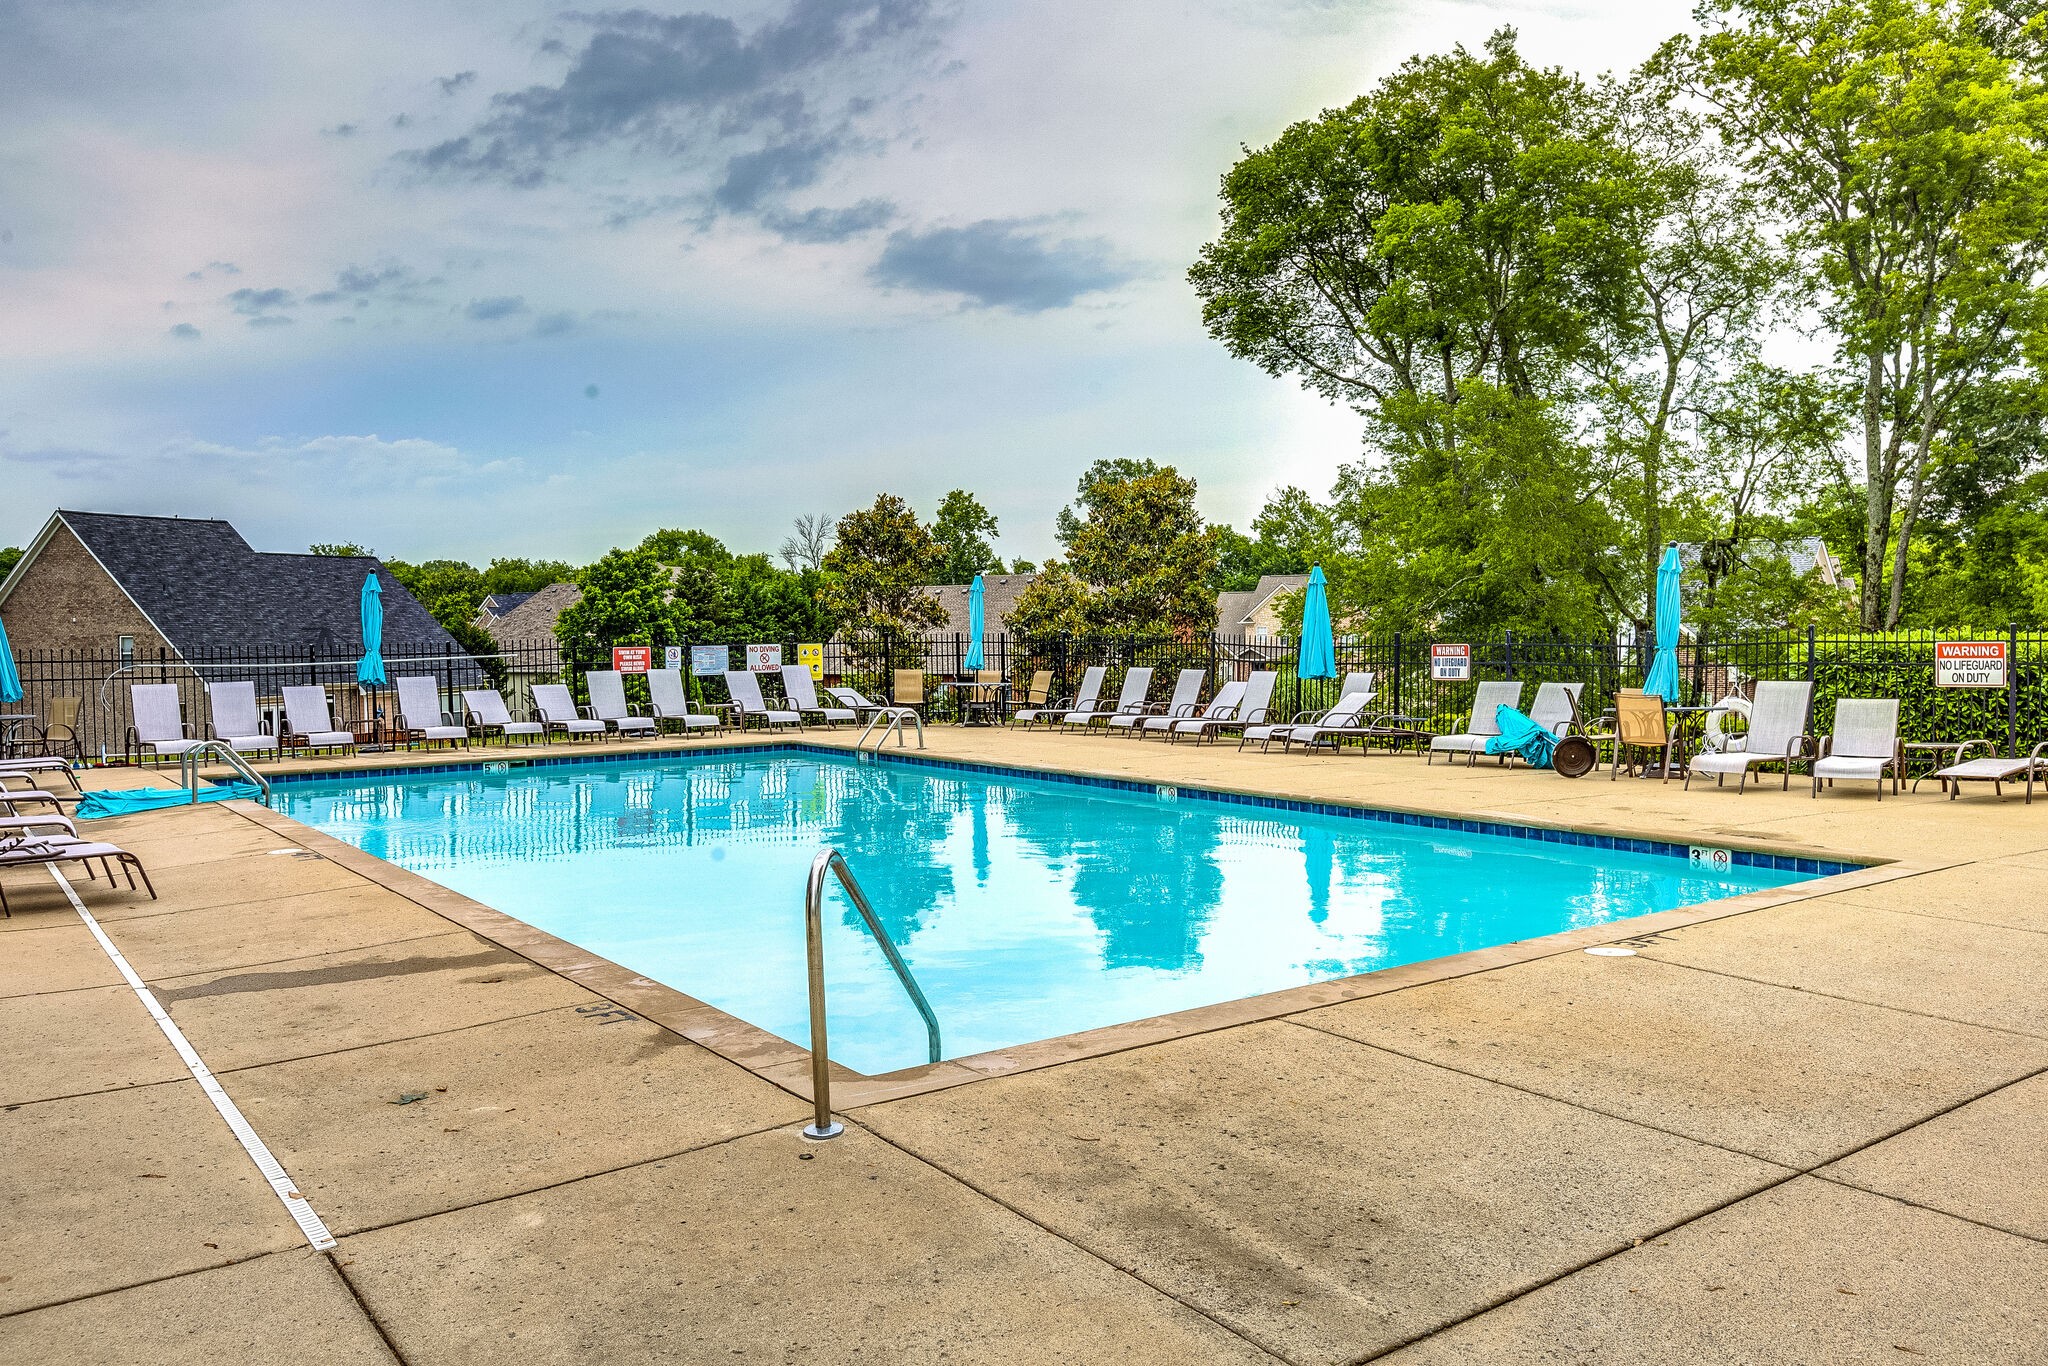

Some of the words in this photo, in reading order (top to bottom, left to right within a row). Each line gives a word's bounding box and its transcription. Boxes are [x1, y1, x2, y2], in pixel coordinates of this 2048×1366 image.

[1436, 646, 1465, 655] WARNING
[1942, 646, 1999, 656] WARNING
[1435, 658, 1440, 666] NO
[1442, 658, 1467, 666] LIFEGUARD
[1940, 660, 1952, 670] NO
[1954, 660, 2002, 670] LIFEGUARD
[1952, 673, 1964, 682] ON
[1967, 673, 1990, 683] DUTY
[1692, 849, 1700, 859] 3
